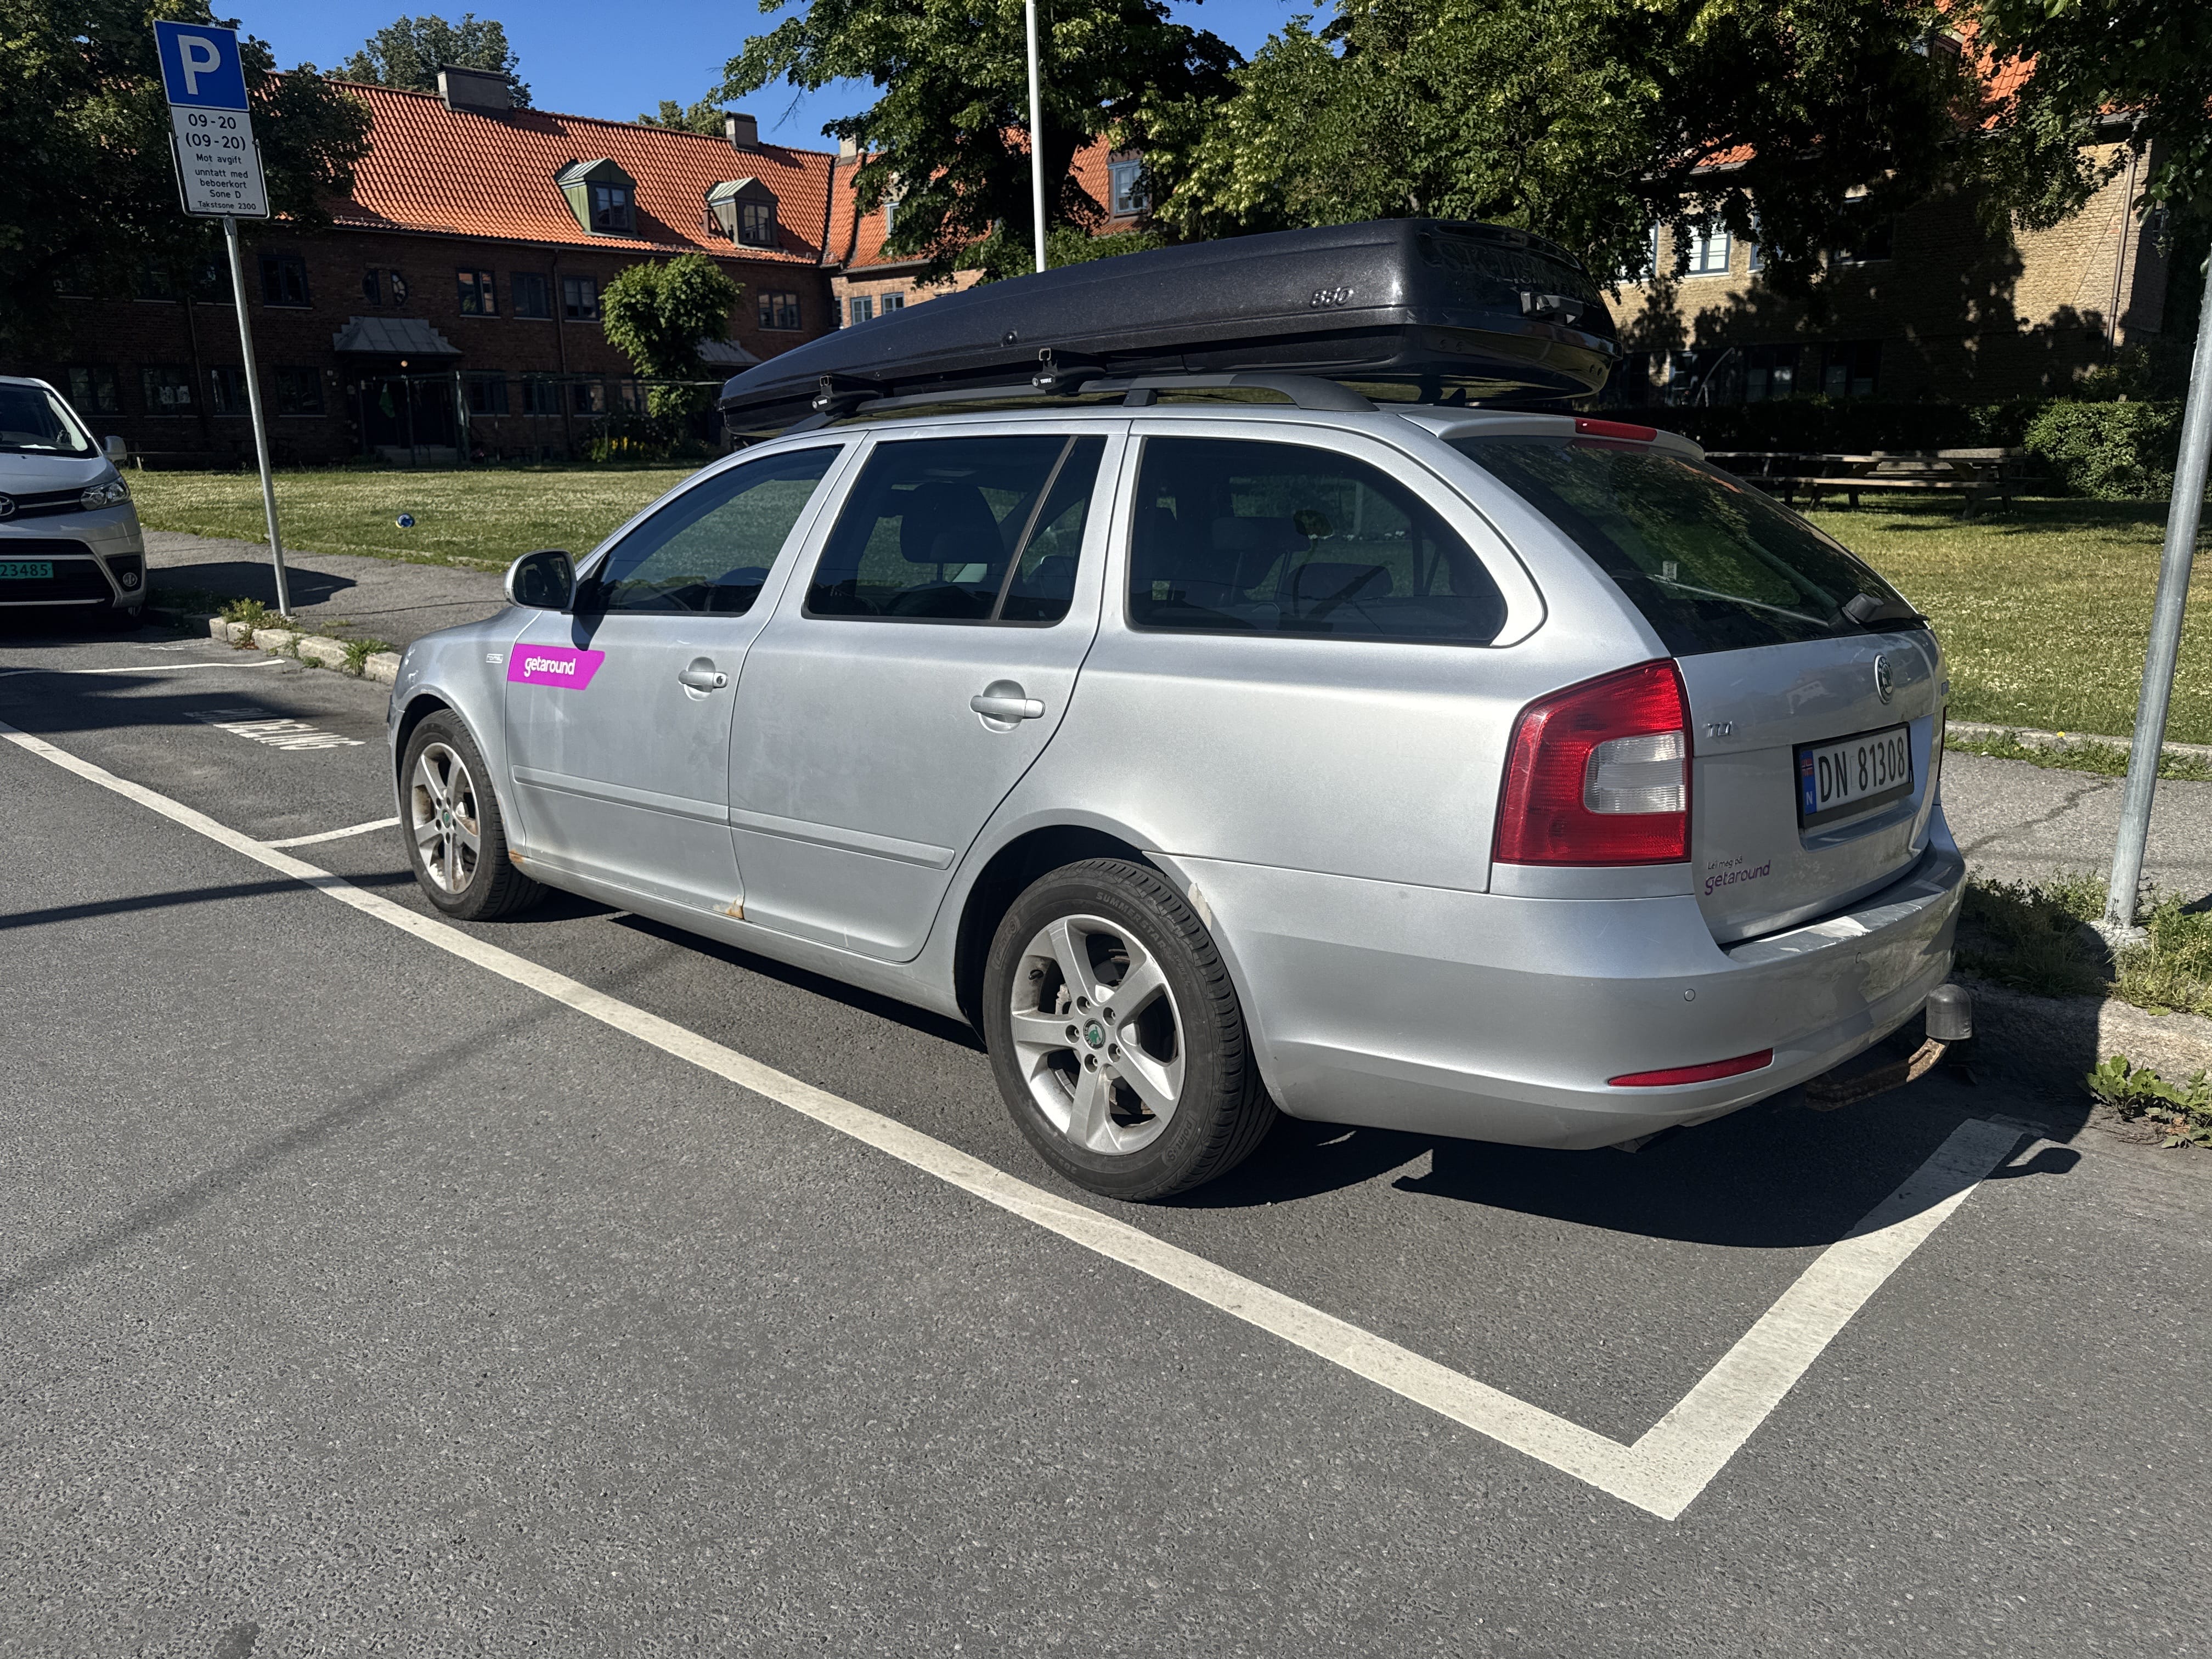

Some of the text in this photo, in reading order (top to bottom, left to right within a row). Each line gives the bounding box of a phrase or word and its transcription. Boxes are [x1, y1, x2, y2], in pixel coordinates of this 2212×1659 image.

[177, 34, 221, 95] P
[196, 153, 242, 165] Mot avgift
[195, 169, 226, 177] unntatt
[200, 178, 247, 189] beboerkort
[210, 189, 241, 199] Sone D
[198, 201, 235, 209] Takstsone
[0, 564, 48, 576] 23485
[524, 656, 576, 678] getaround
[1818, 736, 1905, 803] DN 81308
[1805, 791, 1813, 806] N
[1707, 855, 1743, 870] Lei meg på
[1705, 859, 1771, 895] getaround
[1096, 891, 1167, 952] SUMMERSTAR
